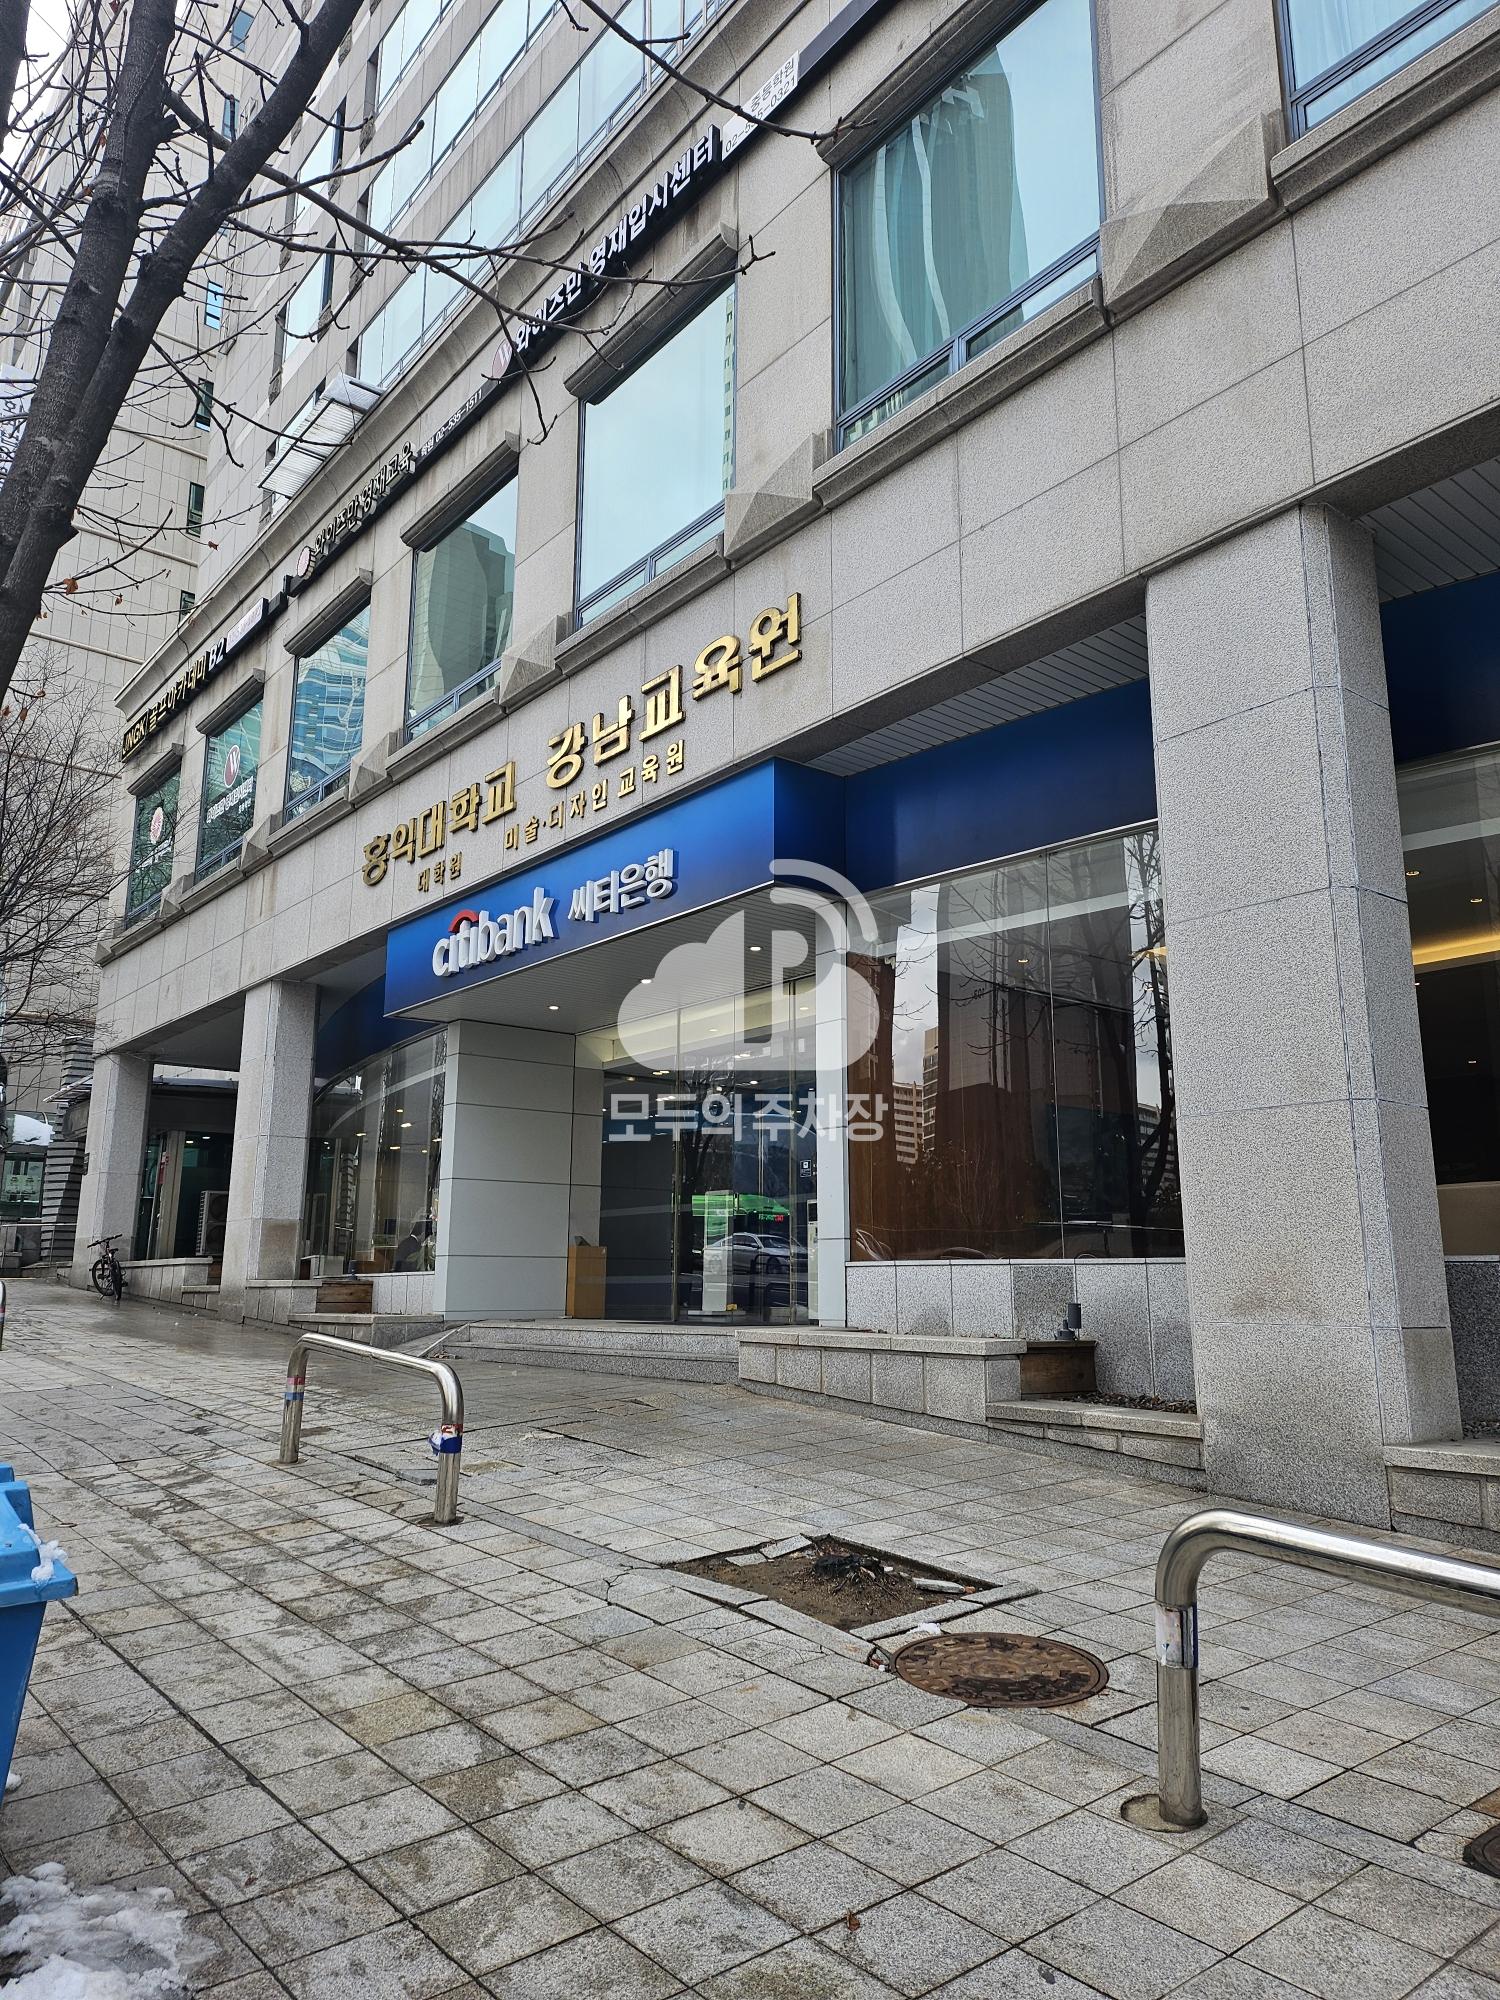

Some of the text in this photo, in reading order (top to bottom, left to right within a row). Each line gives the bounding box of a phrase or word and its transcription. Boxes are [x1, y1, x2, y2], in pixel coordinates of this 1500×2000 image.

[725, 75, 796, 153] 02-55-0321
[589, 124, 713, 276] 영재입시센터
[435, 388, 482, 442] 02-535-1511
[314, 440, 414, 557] 와이즈만 영재교육
[148, 655, 207, 732] 골프아카데미
[208, 637, 225, 671] B2
[362, 592, 802, 886] 홍익대학교 강남교육원
[417, 739, 684, 892] 대학원 미술·디자인 교육원
[432, 848, 675, 977] citibank 씨티은행
